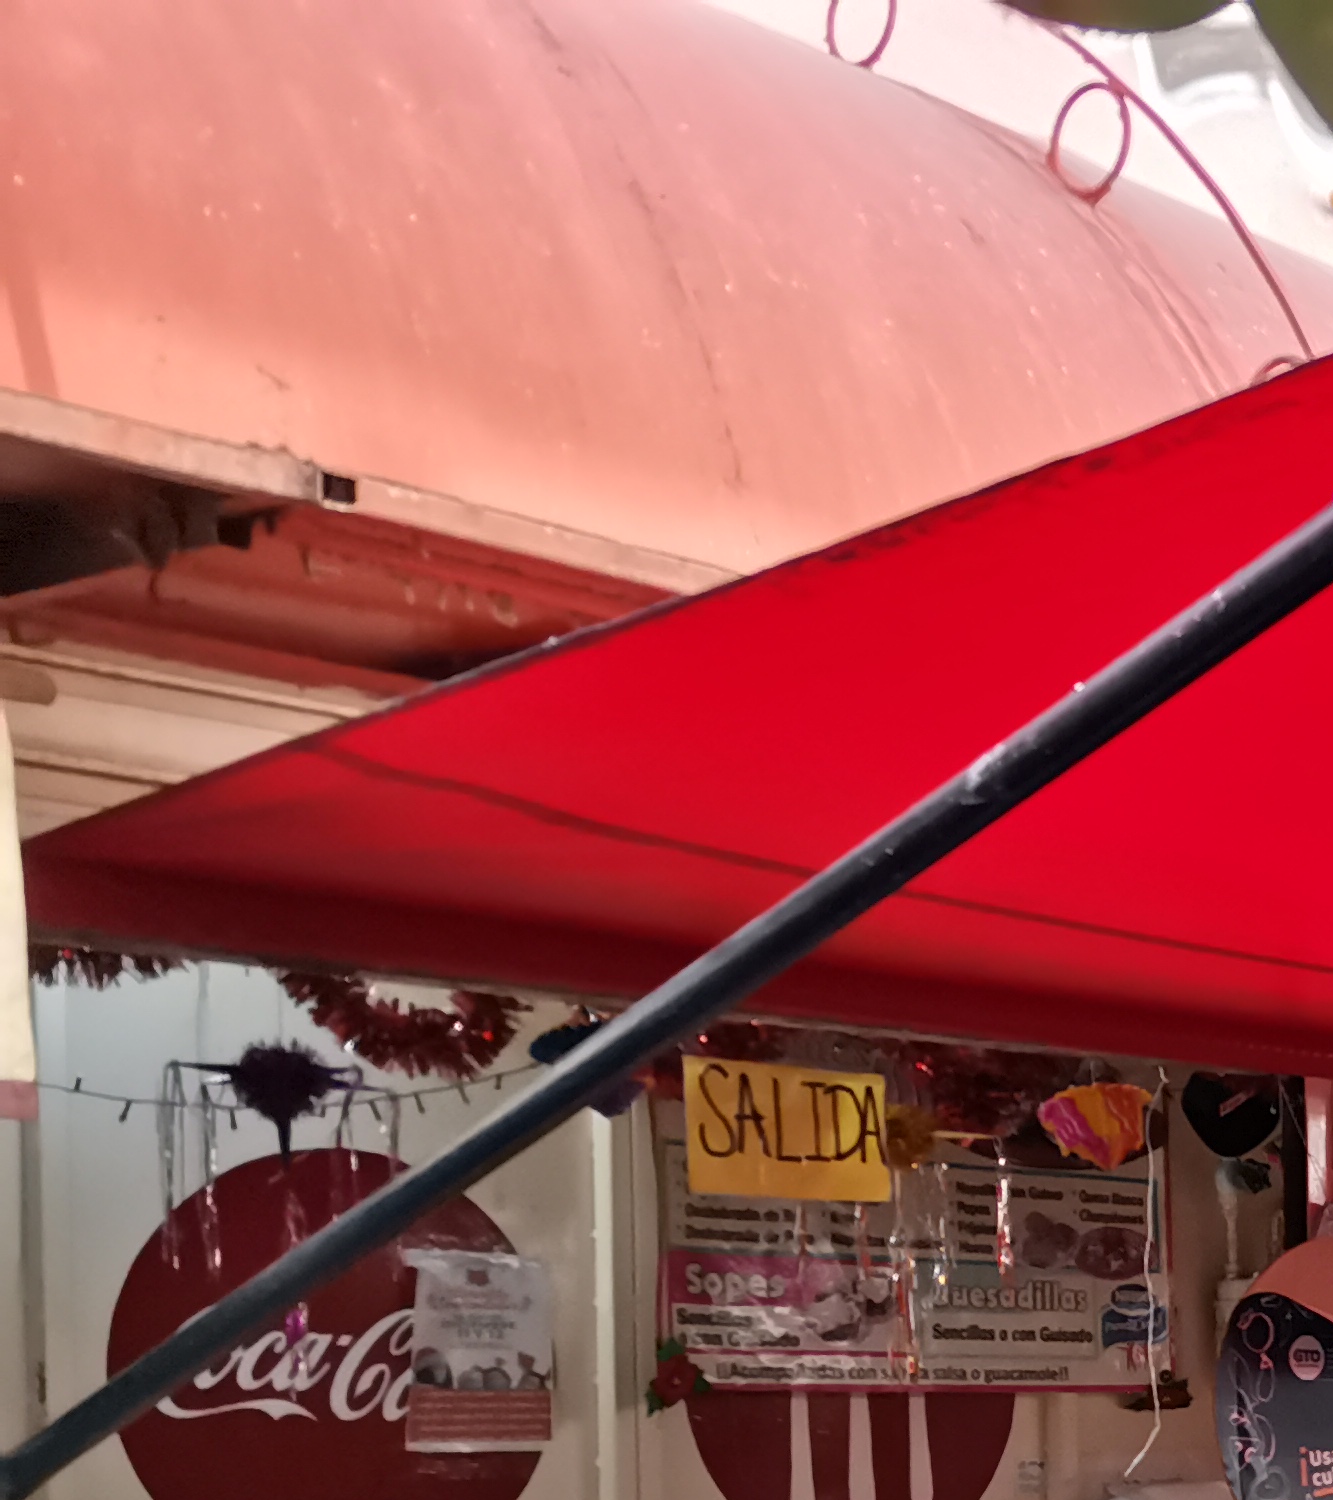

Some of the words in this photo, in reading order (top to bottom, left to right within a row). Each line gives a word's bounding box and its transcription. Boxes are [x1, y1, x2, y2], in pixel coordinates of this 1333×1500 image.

[698, 1063, 887, 1162] SALIDA
[685, 1262, 786, 1305] Sopes
[1011, 1328, 1034, 1342] con
[1040, 1325, 1093, 1343] Guisado
[1293, 1348, 1320, 1363] GTO
[971, 1367, 980, 1380] o
